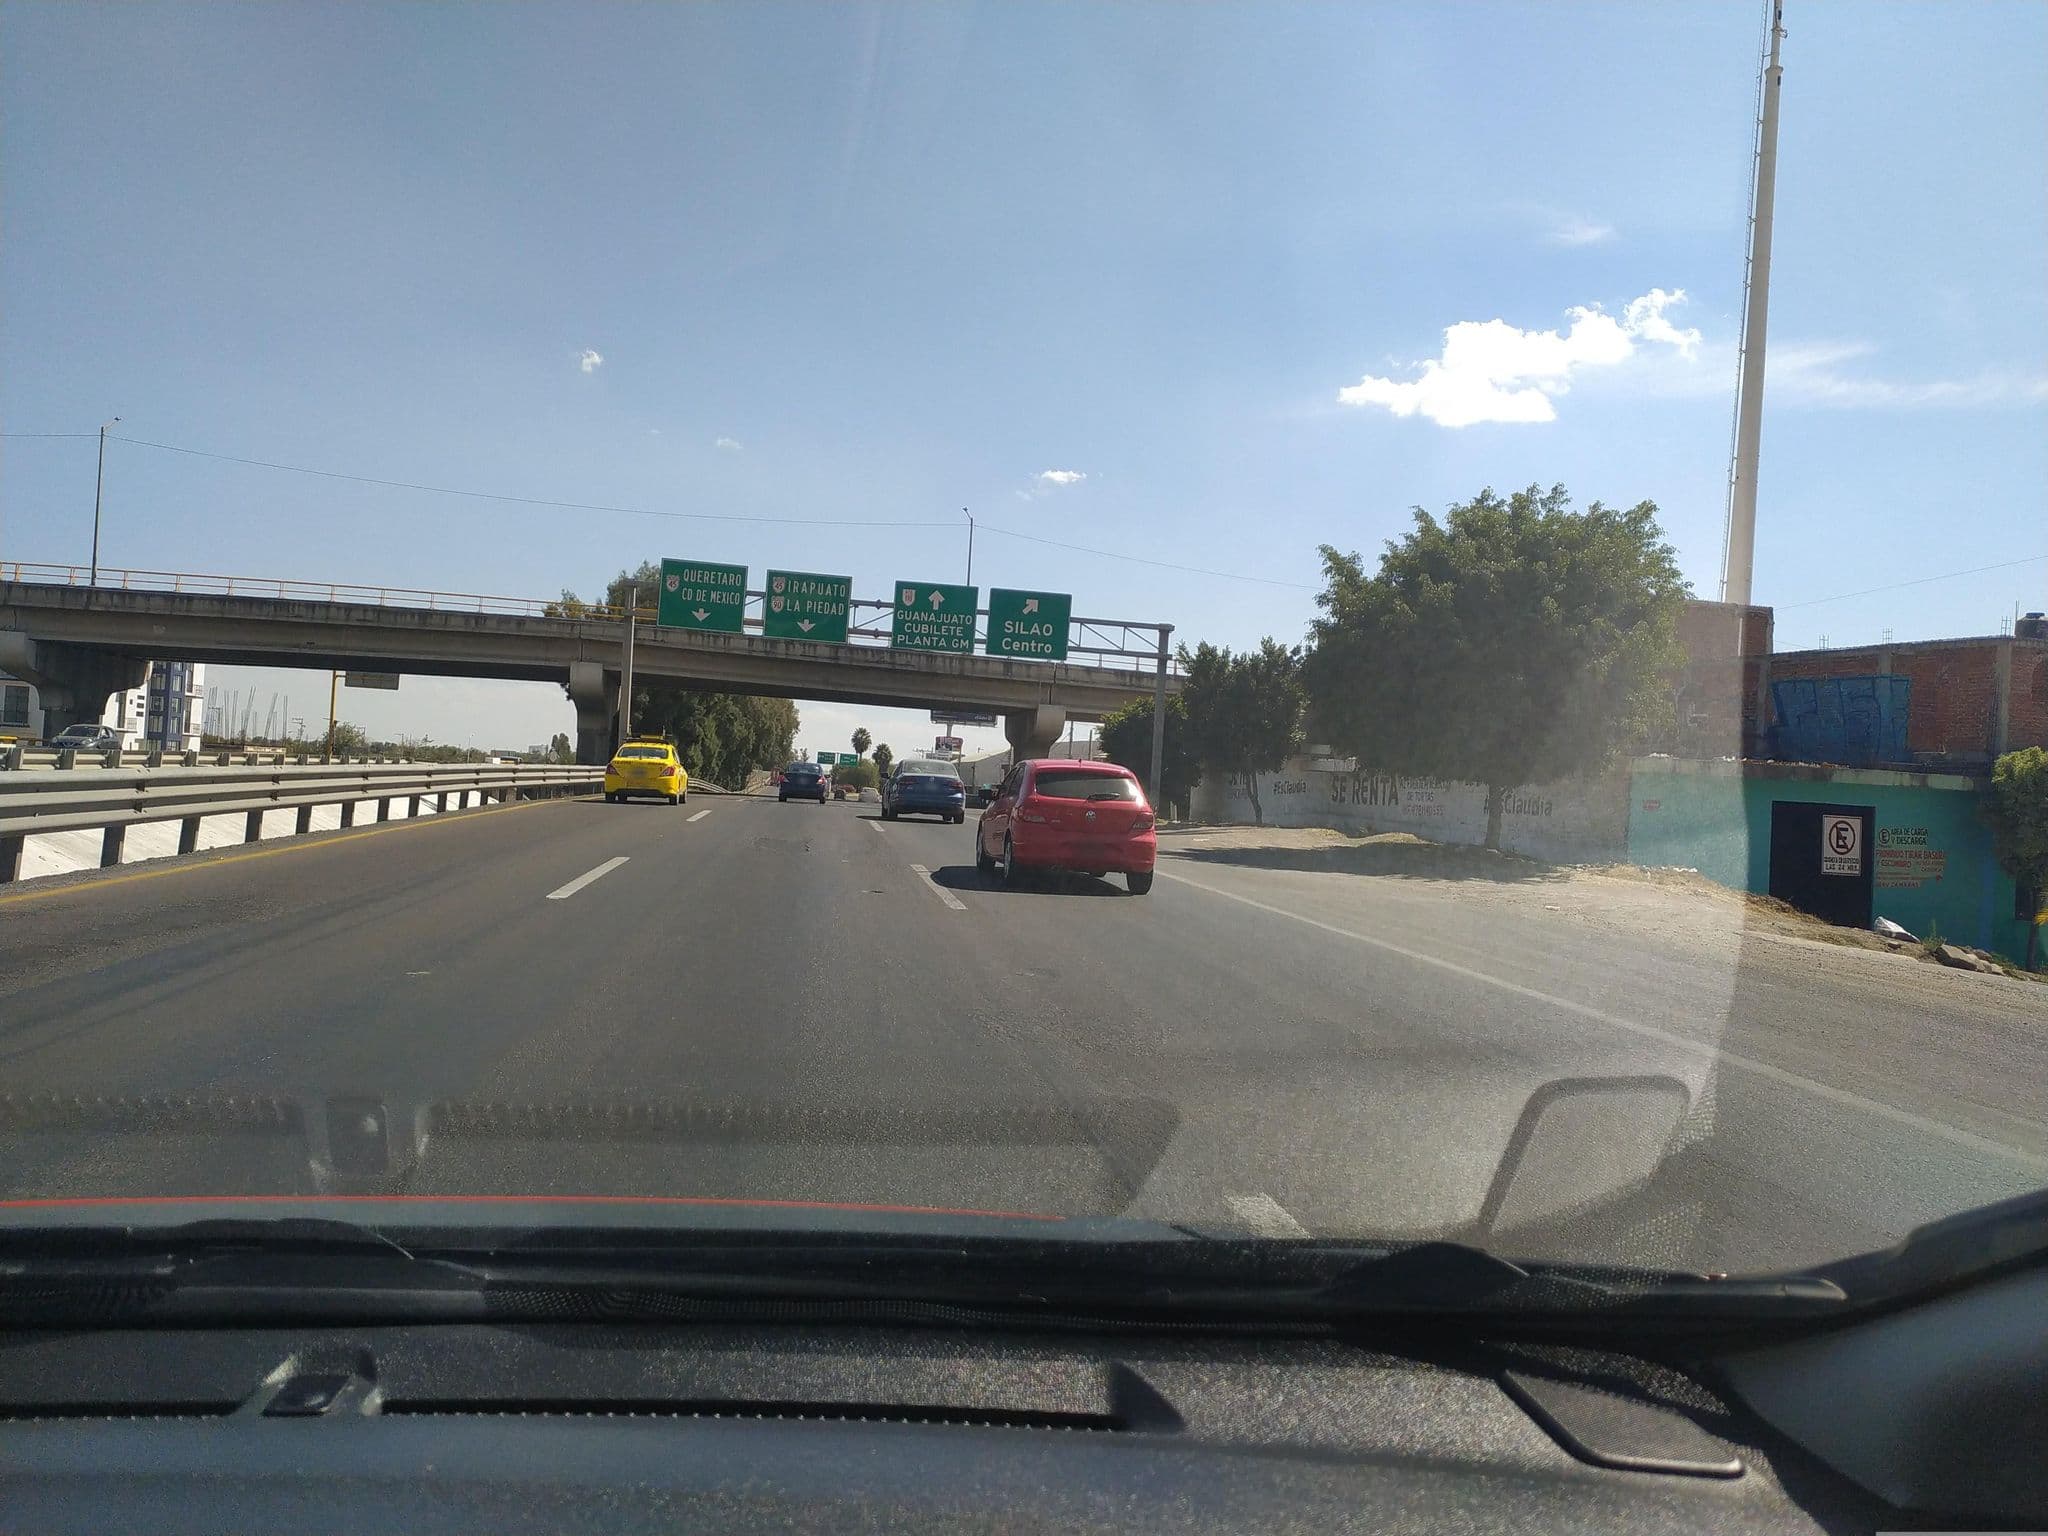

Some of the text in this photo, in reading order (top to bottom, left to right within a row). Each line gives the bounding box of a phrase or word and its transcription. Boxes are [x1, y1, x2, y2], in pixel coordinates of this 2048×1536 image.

[683, 568, 742, 587] QUERETARO
[682, 587, 740, 605] CD DE MEXICO
[787, 580, 846, 598] IRAPUATO
[786, 599, 845, 616] LA PIEDAD
[897, 609, 973, 625] GUANAJUATO
[904, 622, 964, 637] CUBILETE
[1004, 620, 1053, 637] SILAO
[897, 634, 969, 649] PLANTA GM
[1002, 637, 1053, 653] Centro
[1330, 774, 1347, 803] SE
[1352, 773, 1399, 807] RENTA
